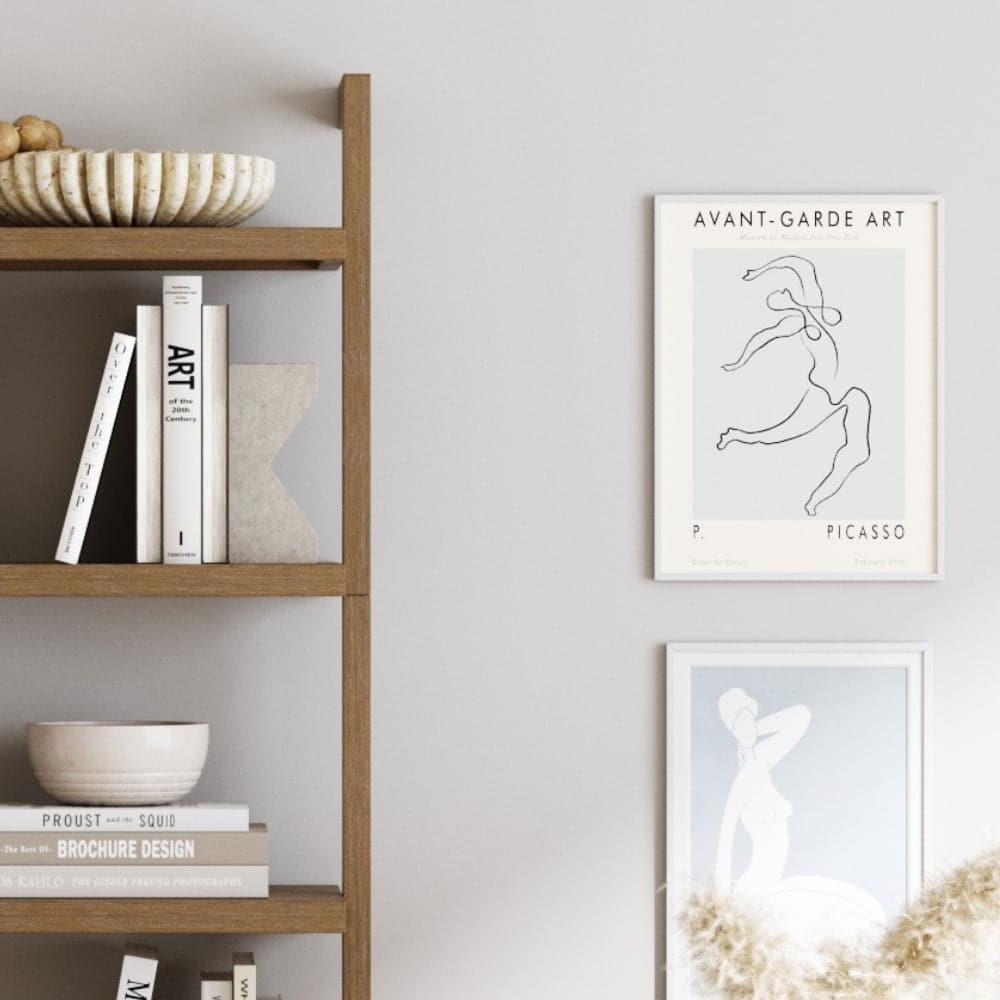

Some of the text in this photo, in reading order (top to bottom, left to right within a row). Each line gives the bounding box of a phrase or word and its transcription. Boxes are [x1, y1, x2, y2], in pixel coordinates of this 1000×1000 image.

[694, 211, 904, 227] AVANT-GARDE ART
[168, 345, 195, 389] ART
[692, 524, 704, 539] P.
[827, 524, 905, 539] PICASSO
[42, 814, 101, 827] PROUST
[139, 814, 176, 827] SQUID
[57, 840, 195, 858] BROCHURE DESIGN
[17, 876, 64, 888] KAHLO
